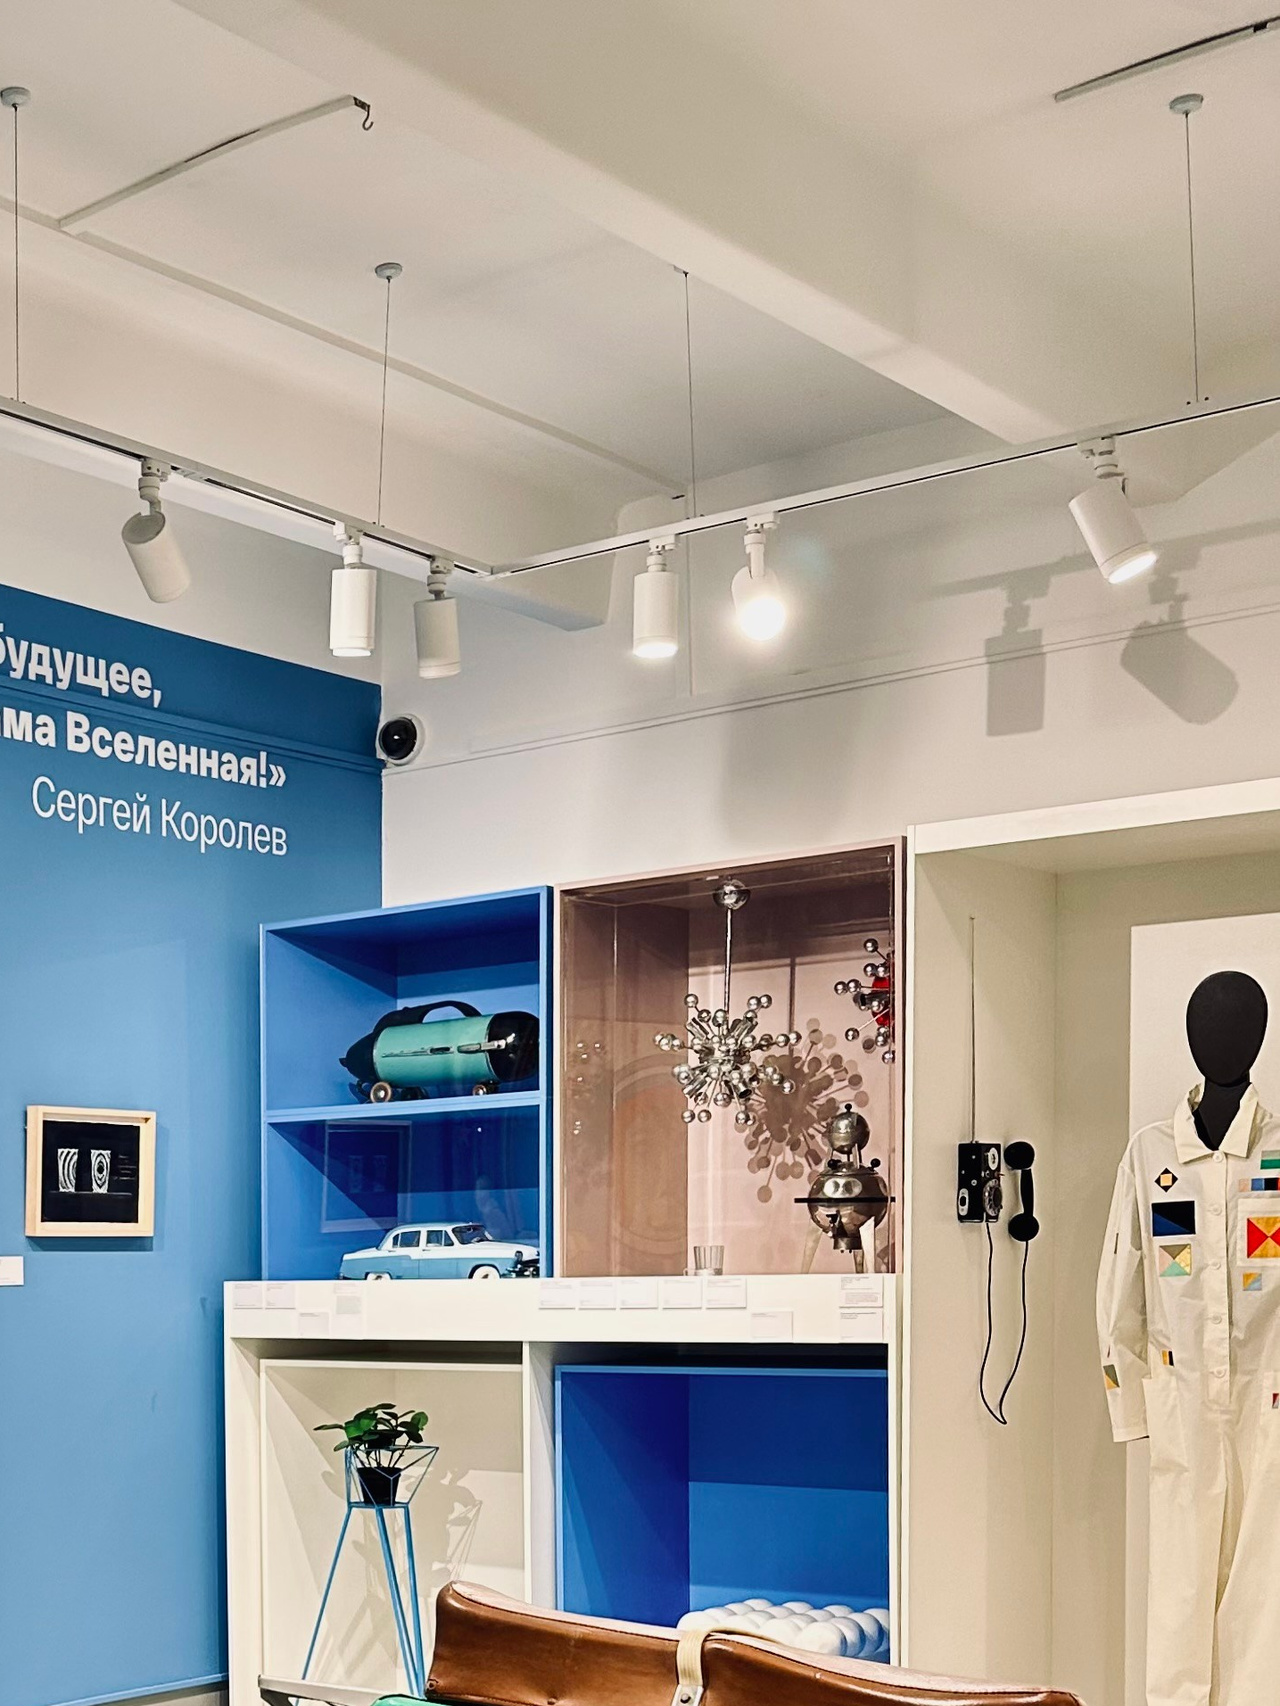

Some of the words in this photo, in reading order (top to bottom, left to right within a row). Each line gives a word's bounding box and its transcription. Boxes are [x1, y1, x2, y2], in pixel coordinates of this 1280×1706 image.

[66, 710, 287, 788] Вселенная!»
[31, 776, 152, 835] Сергей
[161, 798, 287, 857] Королев
